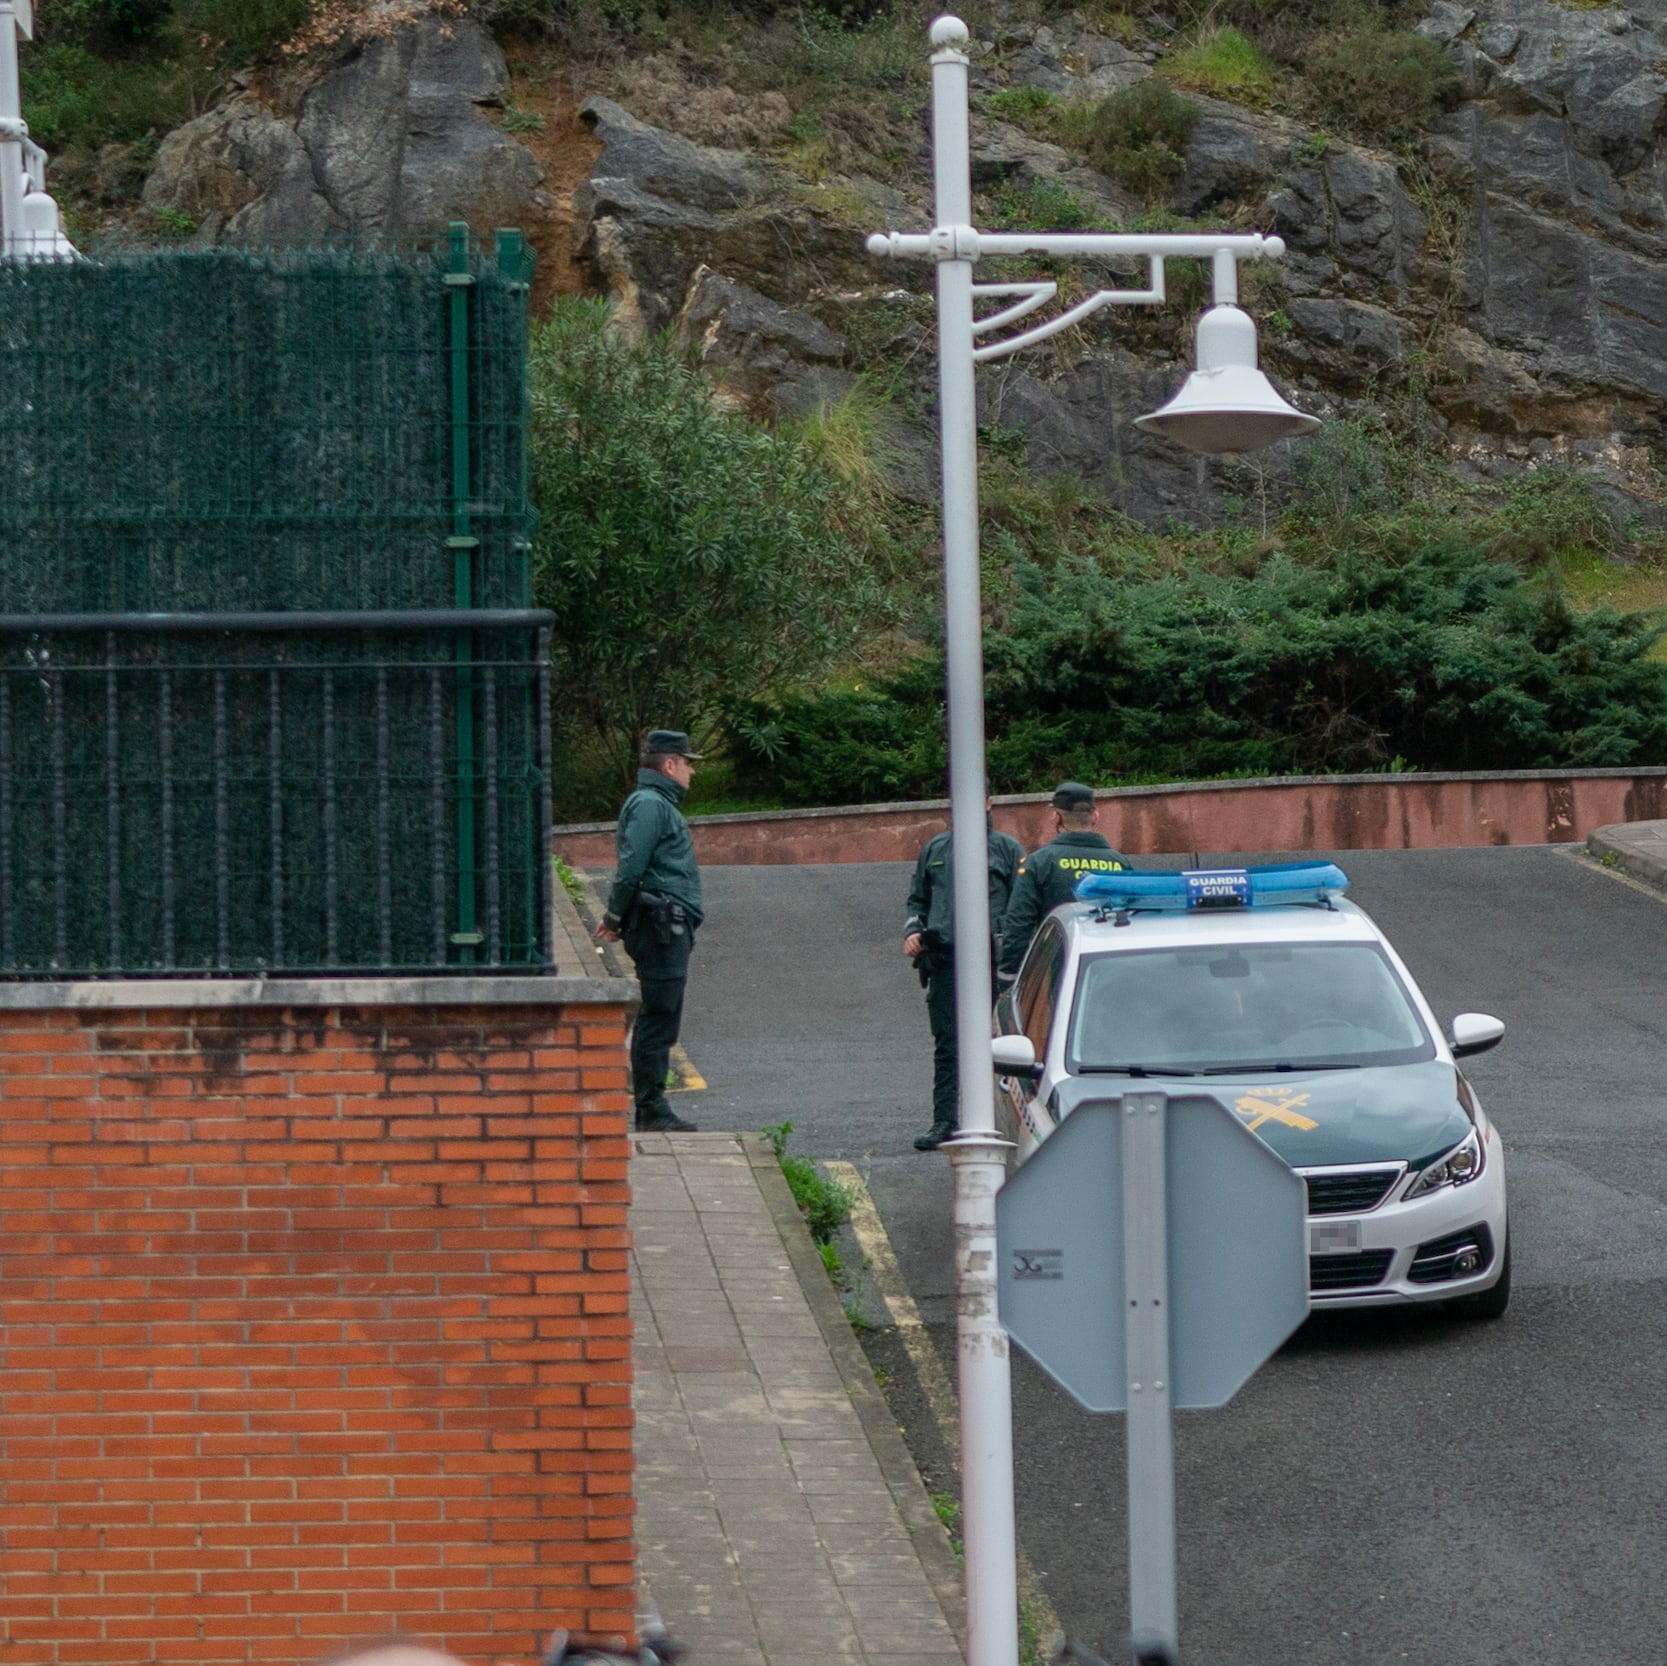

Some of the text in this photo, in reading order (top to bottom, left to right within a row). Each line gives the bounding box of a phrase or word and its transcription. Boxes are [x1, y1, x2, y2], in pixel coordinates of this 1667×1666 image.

[1059, 858, 1123, 872] GUARDIA
[1190, 875, 1247, 886] GUARDIA
[1202, 886, 1237, 895] CIVIL
